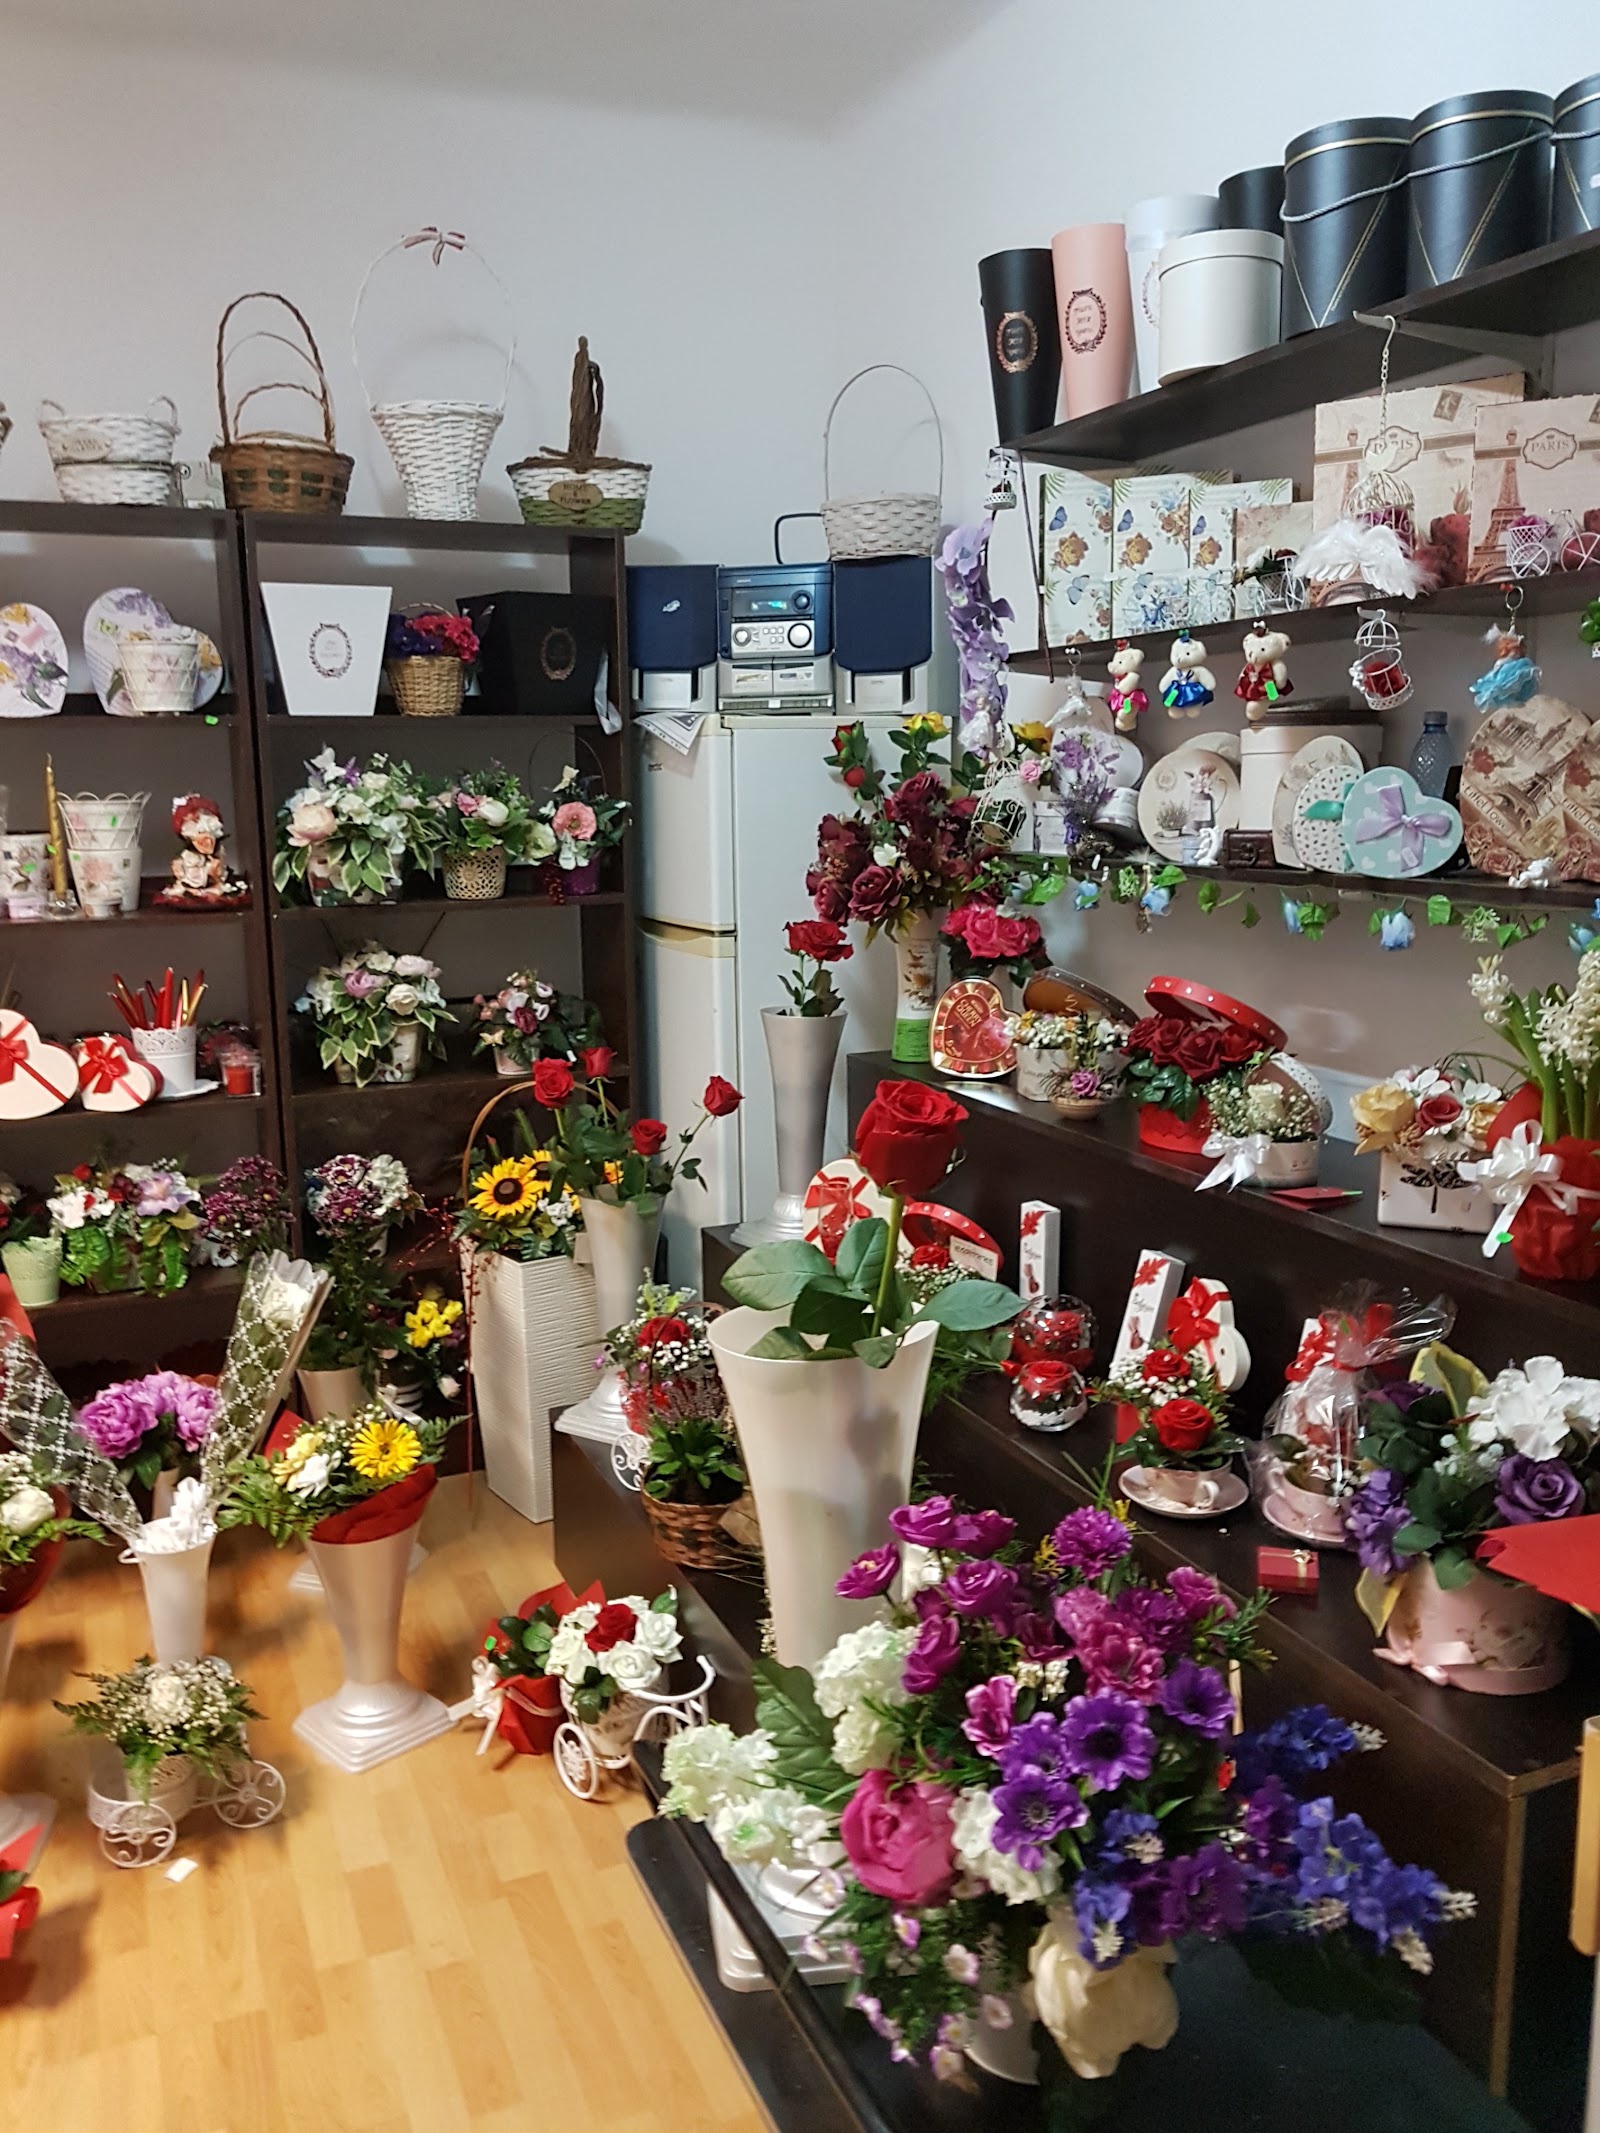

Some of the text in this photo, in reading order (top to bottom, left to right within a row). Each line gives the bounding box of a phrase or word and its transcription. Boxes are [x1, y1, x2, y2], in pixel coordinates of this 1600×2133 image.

[1373, 440, 1413, 454] PIS
[1531, 441, 1570, 452] PARIS
[955, 1004, 977, 1027] QUEEN
[960, 999, 982, 1023] CHERRY
